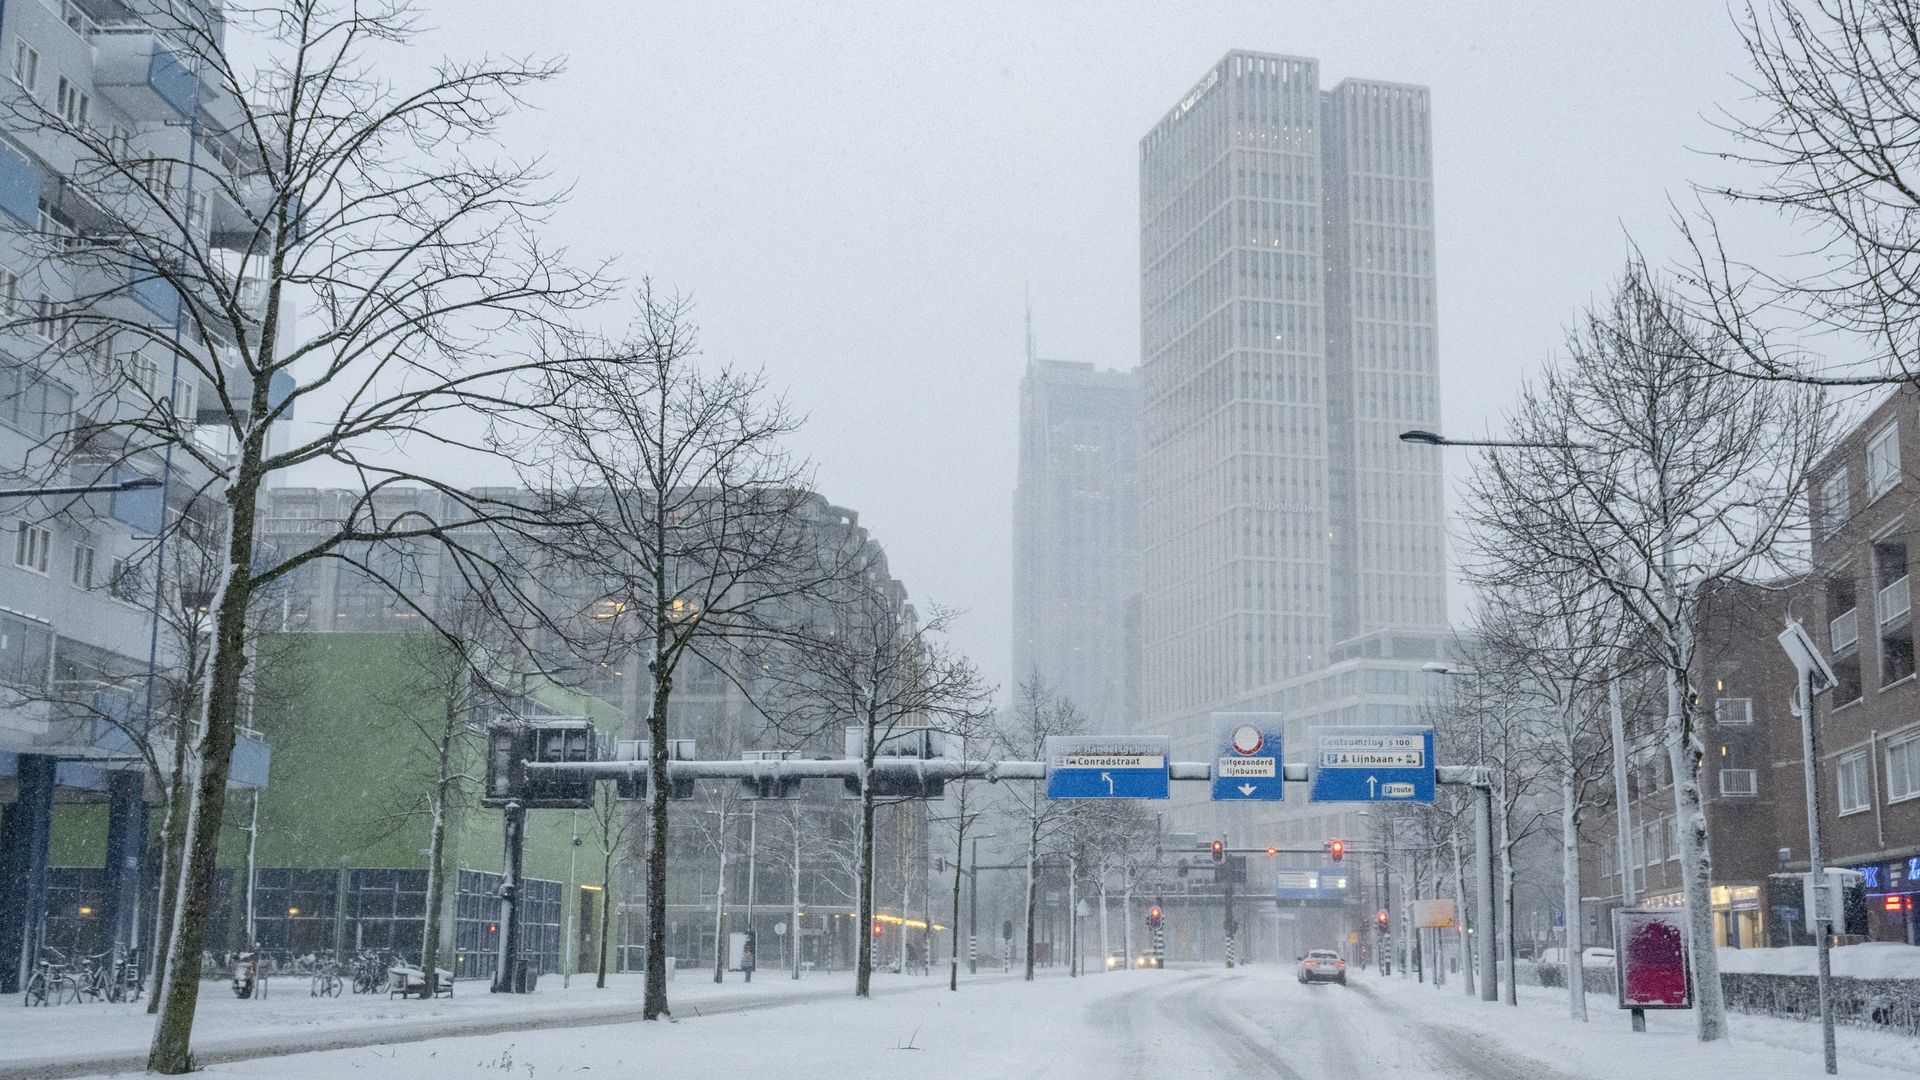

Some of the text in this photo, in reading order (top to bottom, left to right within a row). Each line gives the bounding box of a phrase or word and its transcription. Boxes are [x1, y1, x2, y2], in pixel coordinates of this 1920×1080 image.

[1321, 739, 1384, 748] Centrumring
[1078, 757, 1140, 766] Conradstraat
[1352, 755, 1394, 764] Lijnbaan
[1226, 768, 1268, 776] lijnbussen
[1393, 785, 1412, 793] route
